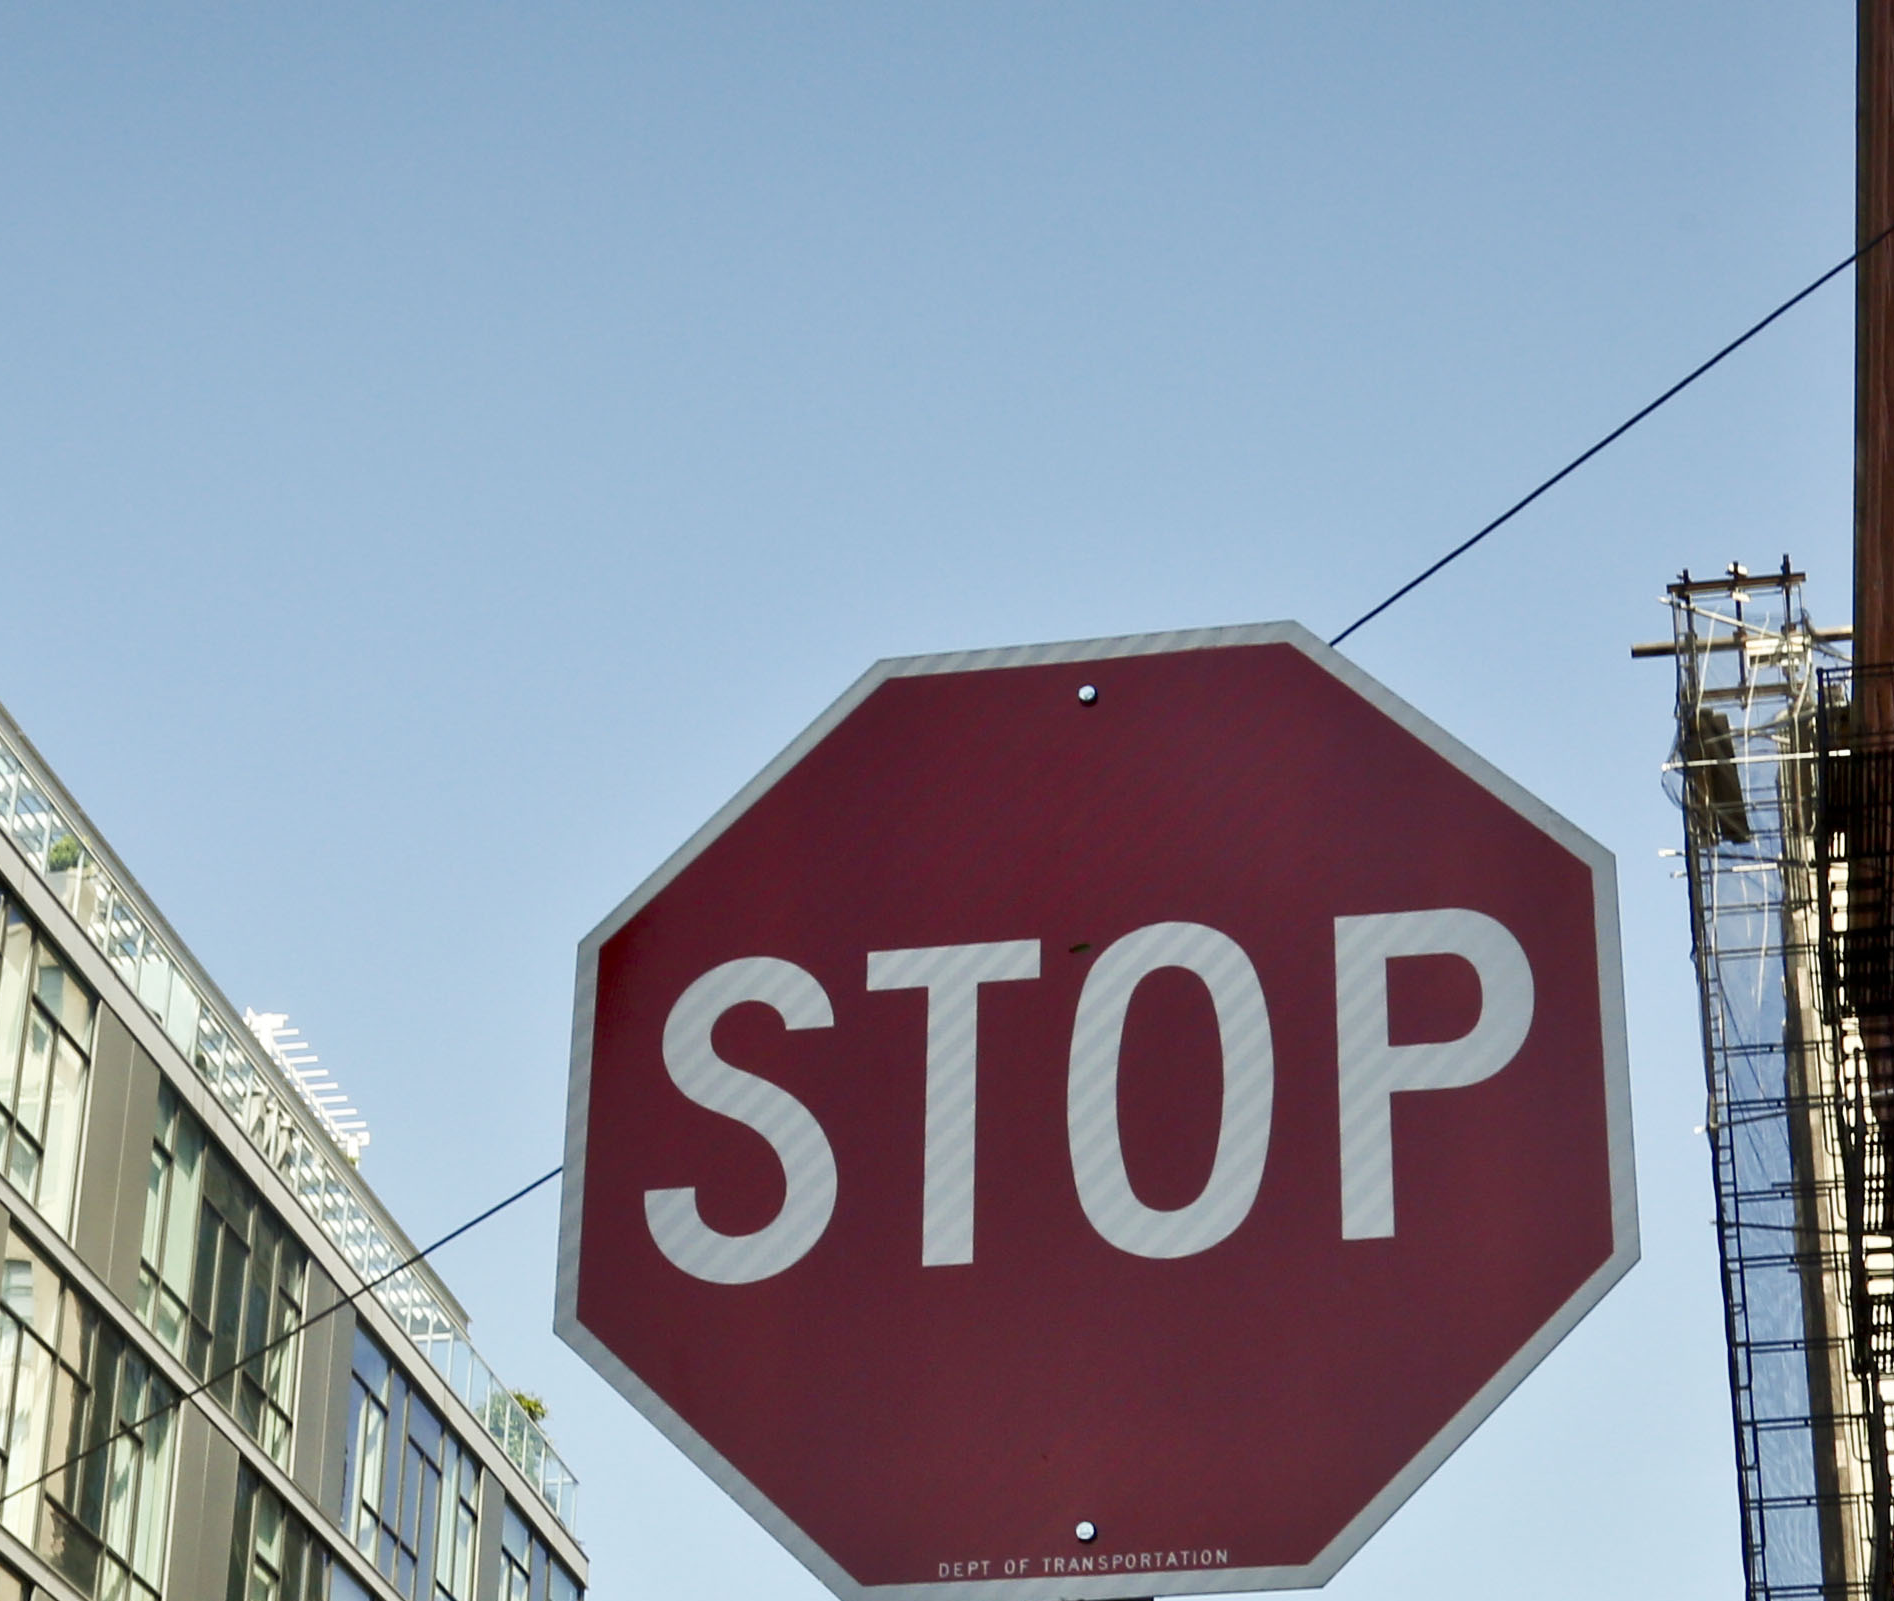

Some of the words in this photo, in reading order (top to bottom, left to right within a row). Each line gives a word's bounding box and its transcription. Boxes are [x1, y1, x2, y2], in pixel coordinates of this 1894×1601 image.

[644, 908, 1536, 1286] STOP
[938, 1560, 991, 1579] DEPT
[1004, 1558, 1030, 1576] OF
[1042, 1549, 1229, 1573] TRANSPORTATION
